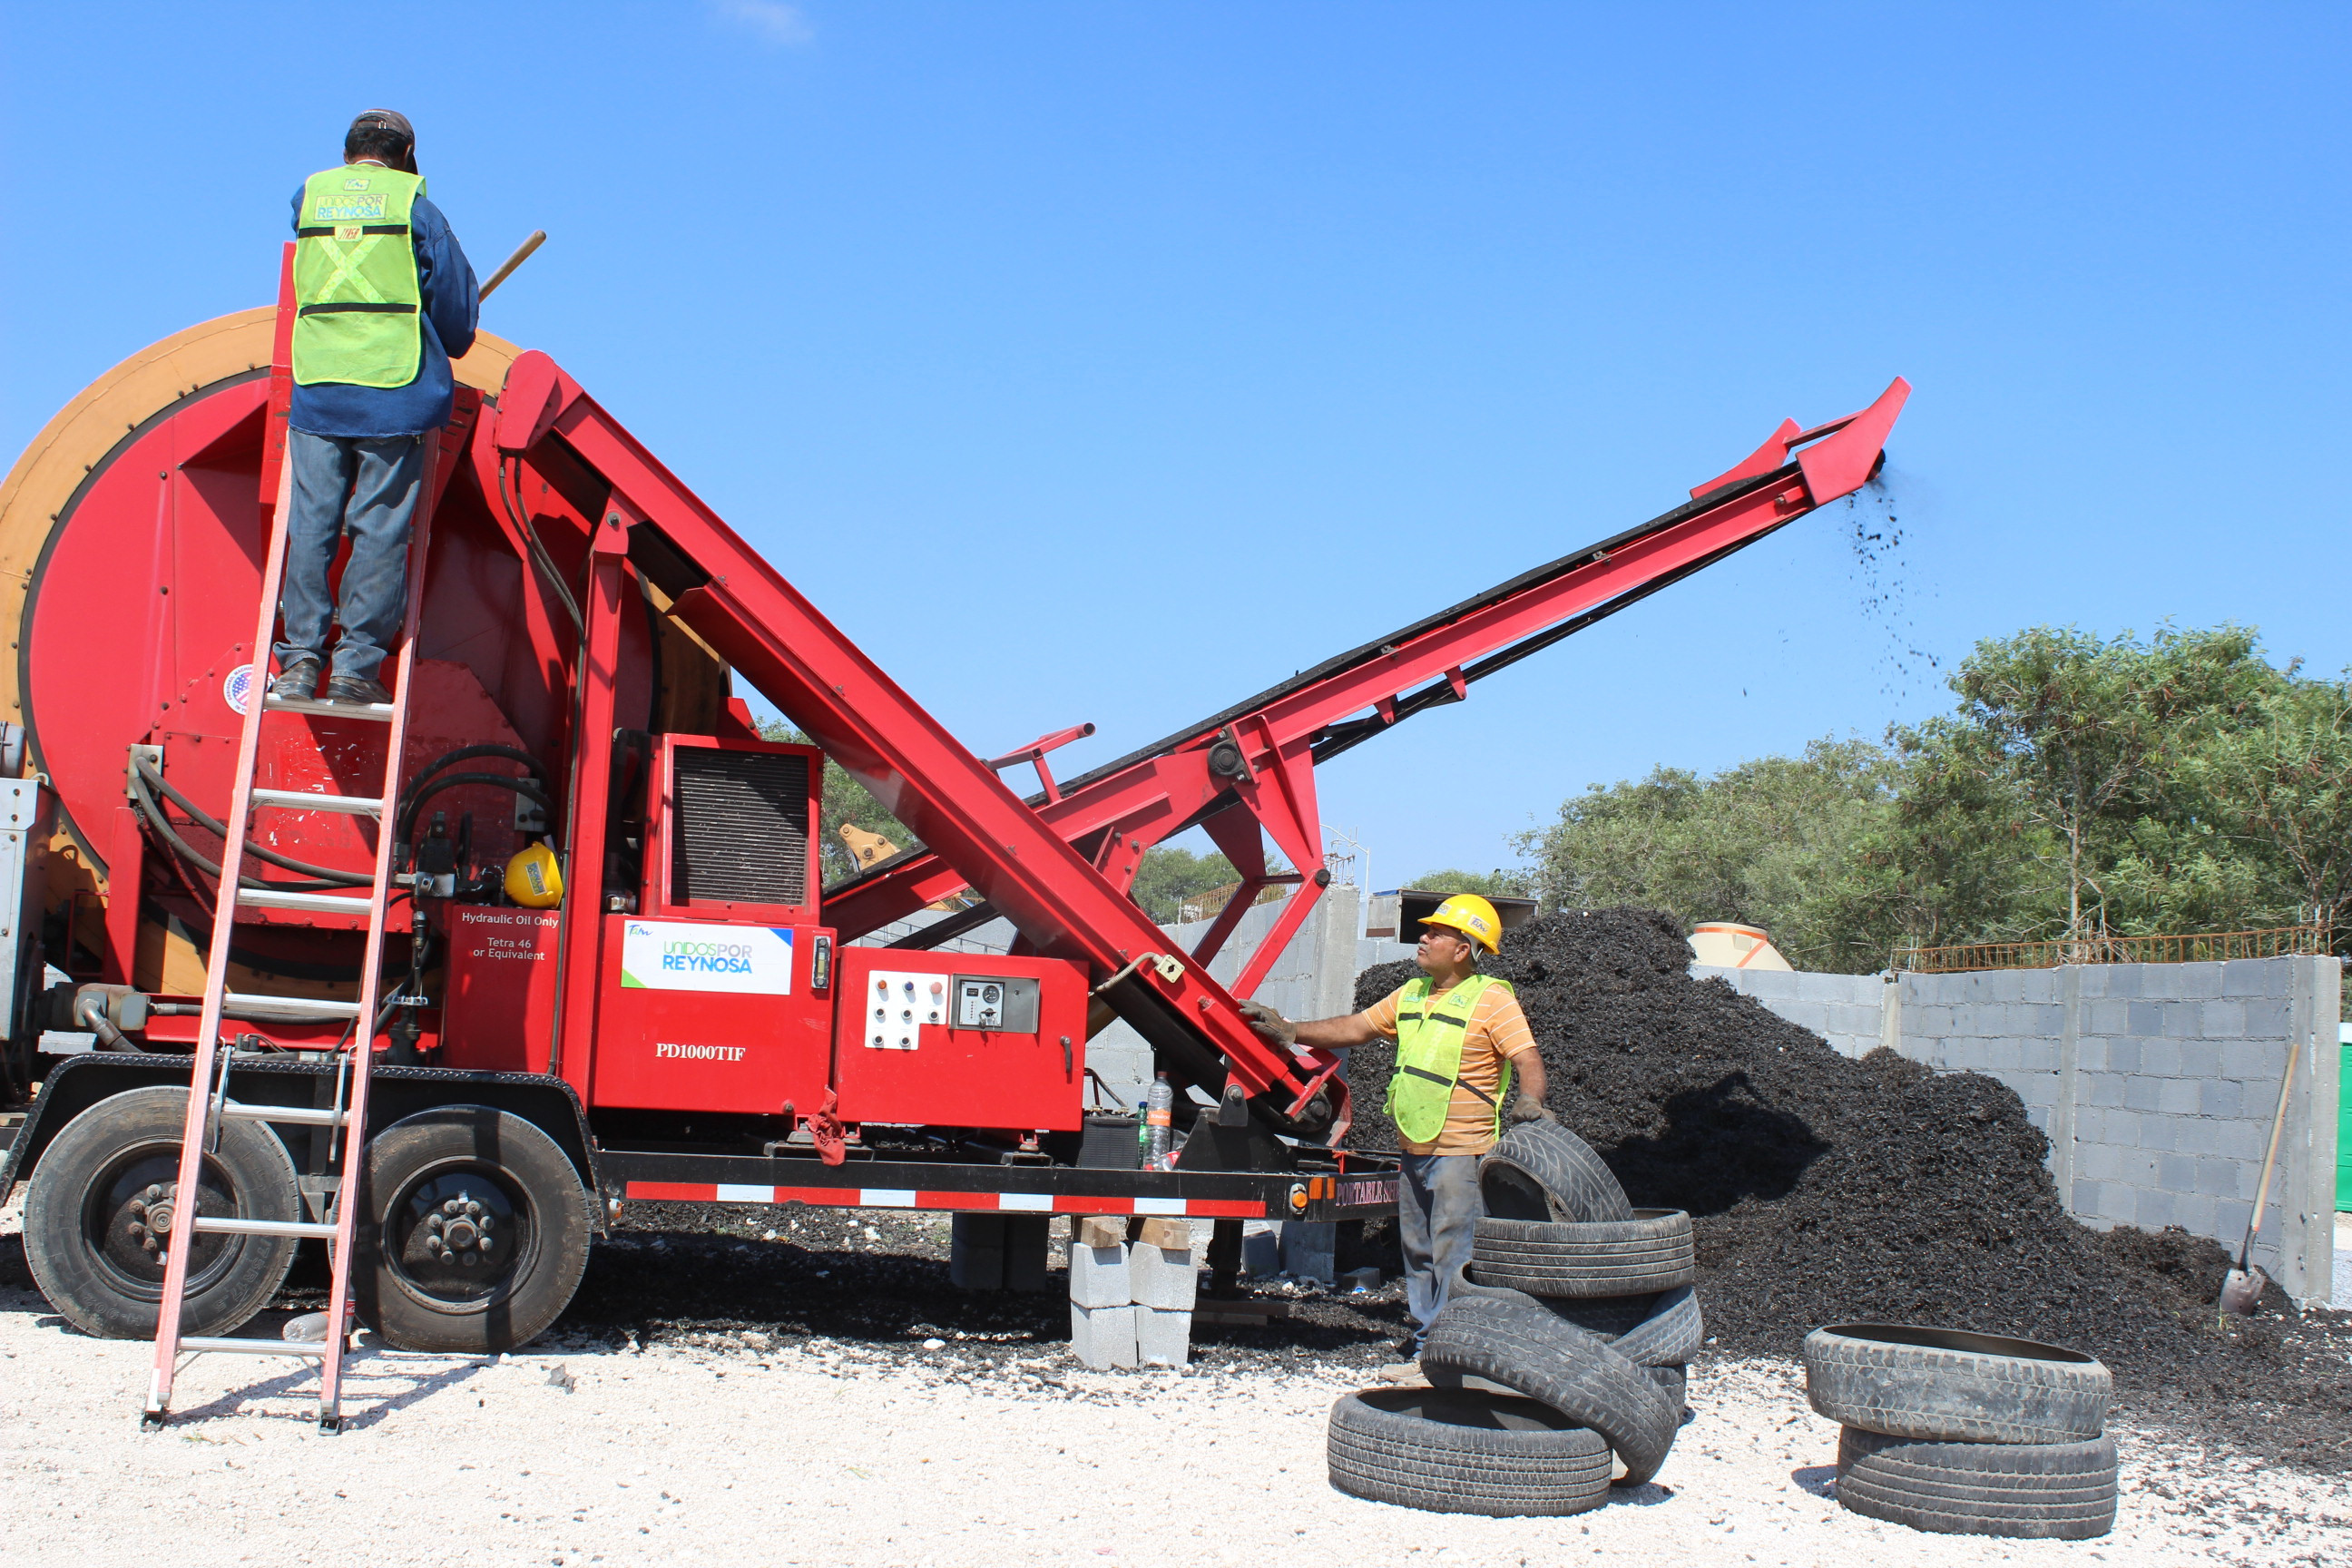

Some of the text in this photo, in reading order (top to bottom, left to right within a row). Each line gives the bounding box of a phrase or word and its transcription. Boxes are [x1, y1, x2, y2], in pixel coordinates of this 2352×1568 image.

[318, 205, 382, 218] REYNOSA
[462, 912, 559, 929] Hydraulic Oil Only
[487, 936, 532, 949] Tetra 46
[473, 948, 545, 961] or Equivalent
[662, 954, 753, 974] REYNOSA
[655, 1043, 746, 1062] PD1000TIF
[1335, 1181, 1382, 1207] PORTABLE
